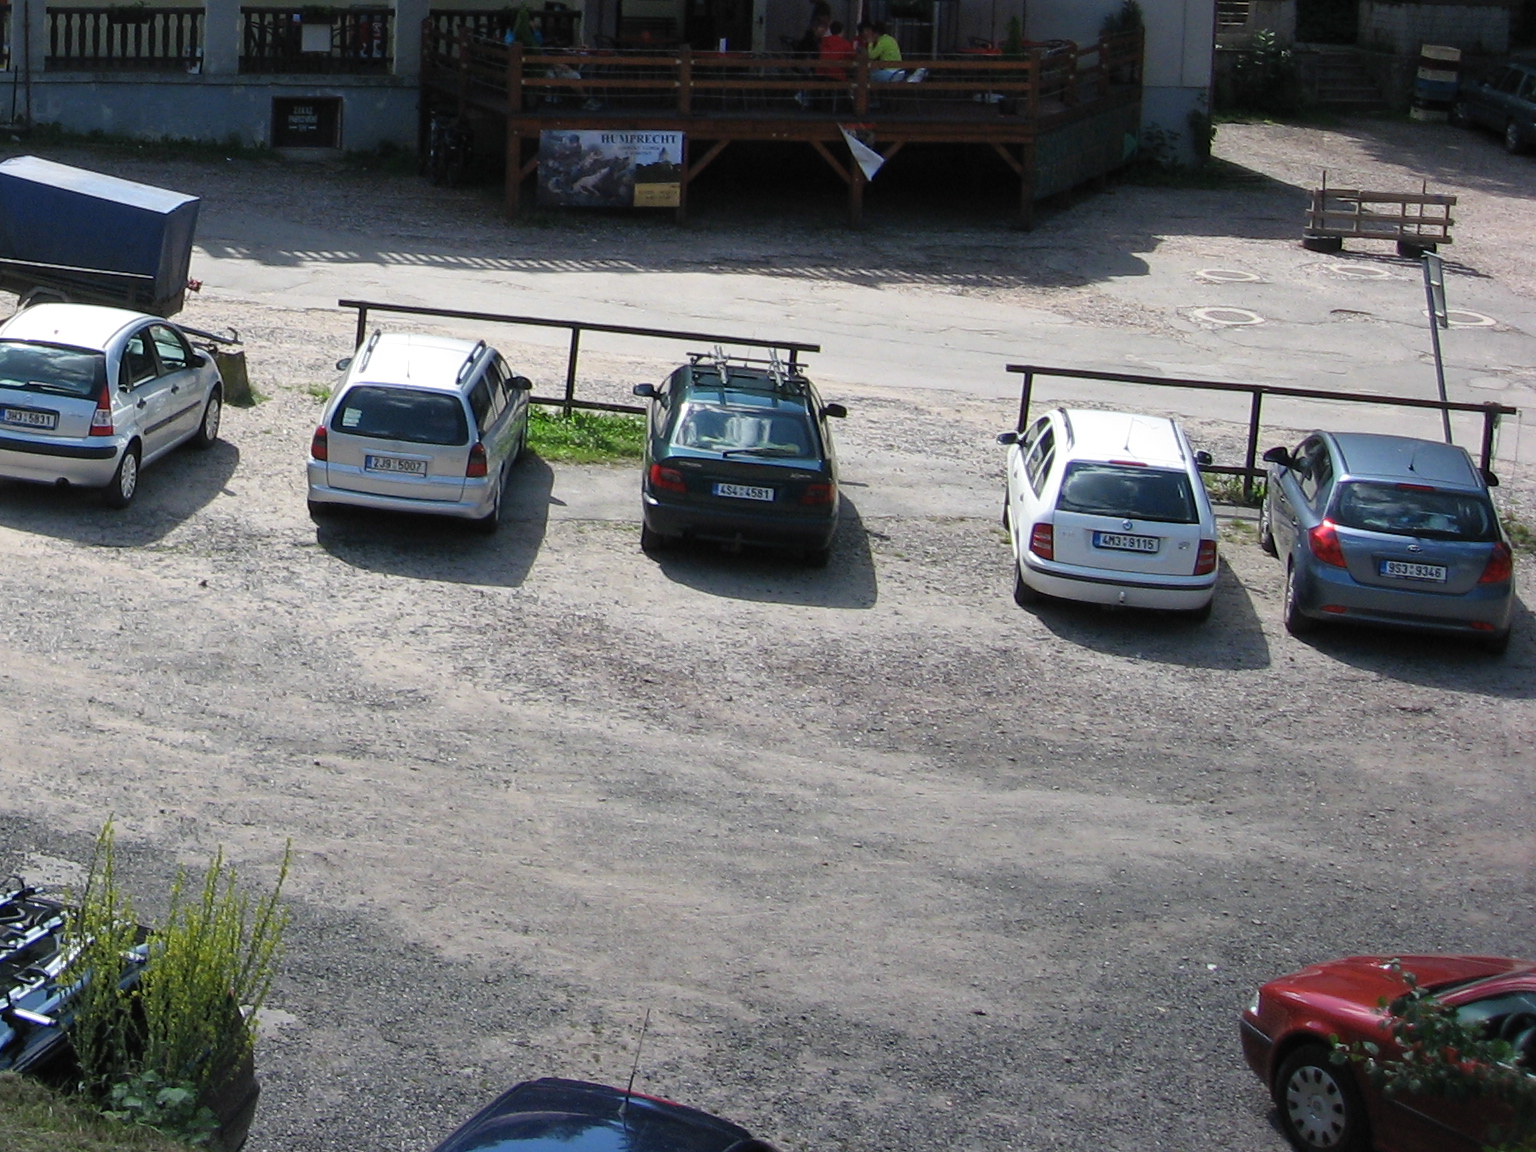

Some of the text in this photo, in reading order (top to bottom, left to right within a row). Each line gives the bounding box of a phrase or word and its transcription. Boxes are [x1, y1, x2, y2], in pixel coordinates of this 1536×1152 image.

[601, 134, 677, 144] HUMPRECHT
[373, 457, 422, 472] 2J9 5007
[720, 484, 770, 500] 4S4 4581
[1102, 534, 1121, 547] 4M3
[1388, 562, 1442, 579] 9S3 9346
